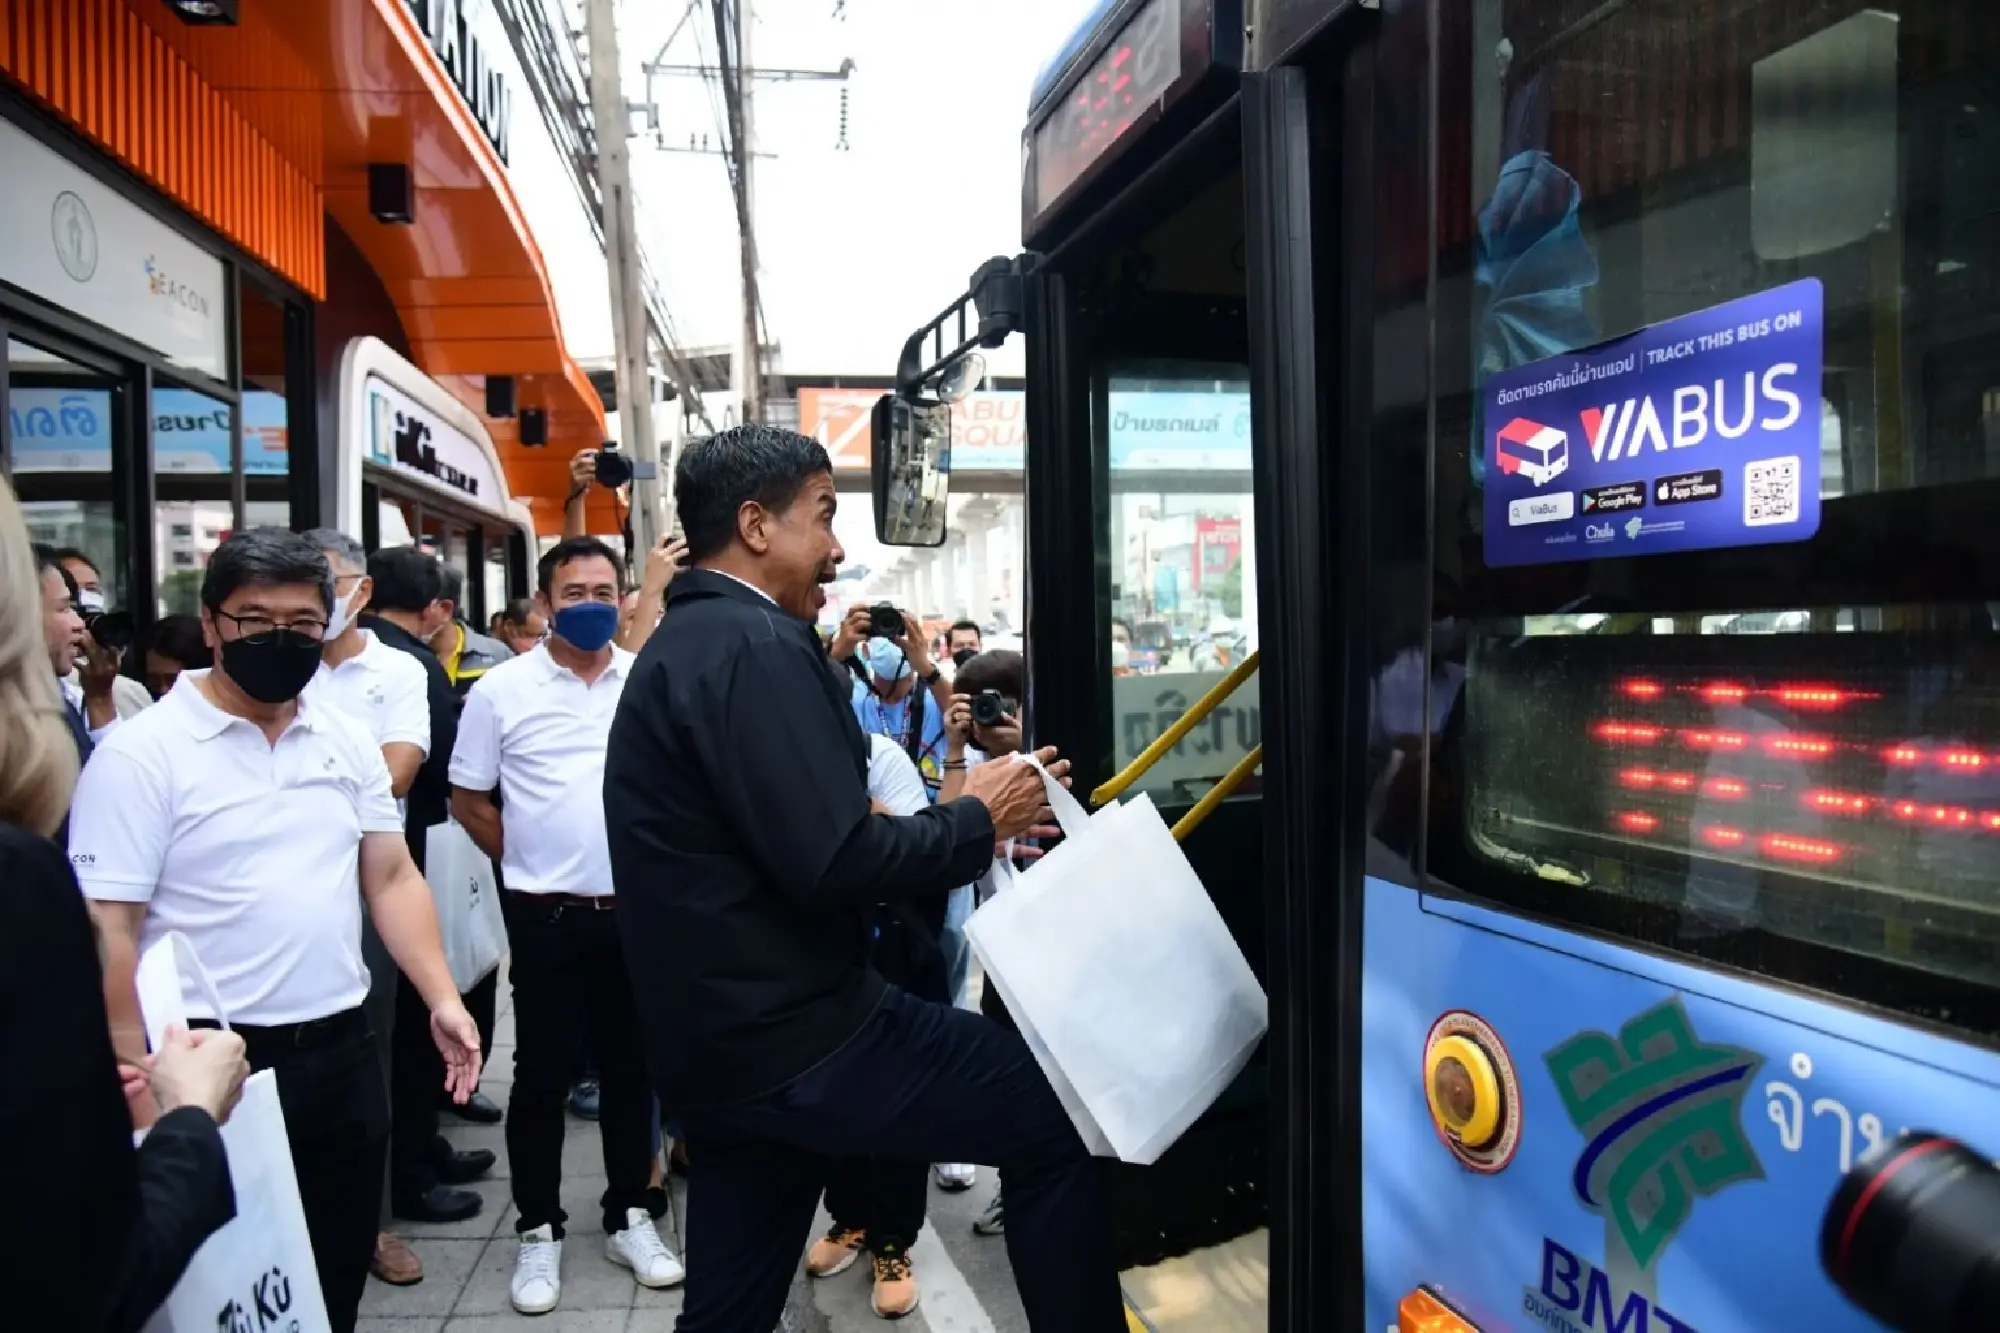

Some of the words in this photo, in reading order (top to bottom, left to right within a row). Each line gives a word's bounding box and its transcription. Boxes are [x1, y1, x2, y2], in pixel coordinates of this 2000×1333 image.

[1646, 340, 1696, 364] TRACK
[1698, 329, 1735, 352] THIS
[1738, 320, 1770, 342] BUS
[1775, 311, 1803, 331] ON
[1671, 486, 1691, 499] App
[1692, 483, 1717, 495] Store
[1598, 495, 1625, 508] Google
[1625, 494, 1642, 506] Play
[1585, 522, 1615, 539] Chula
